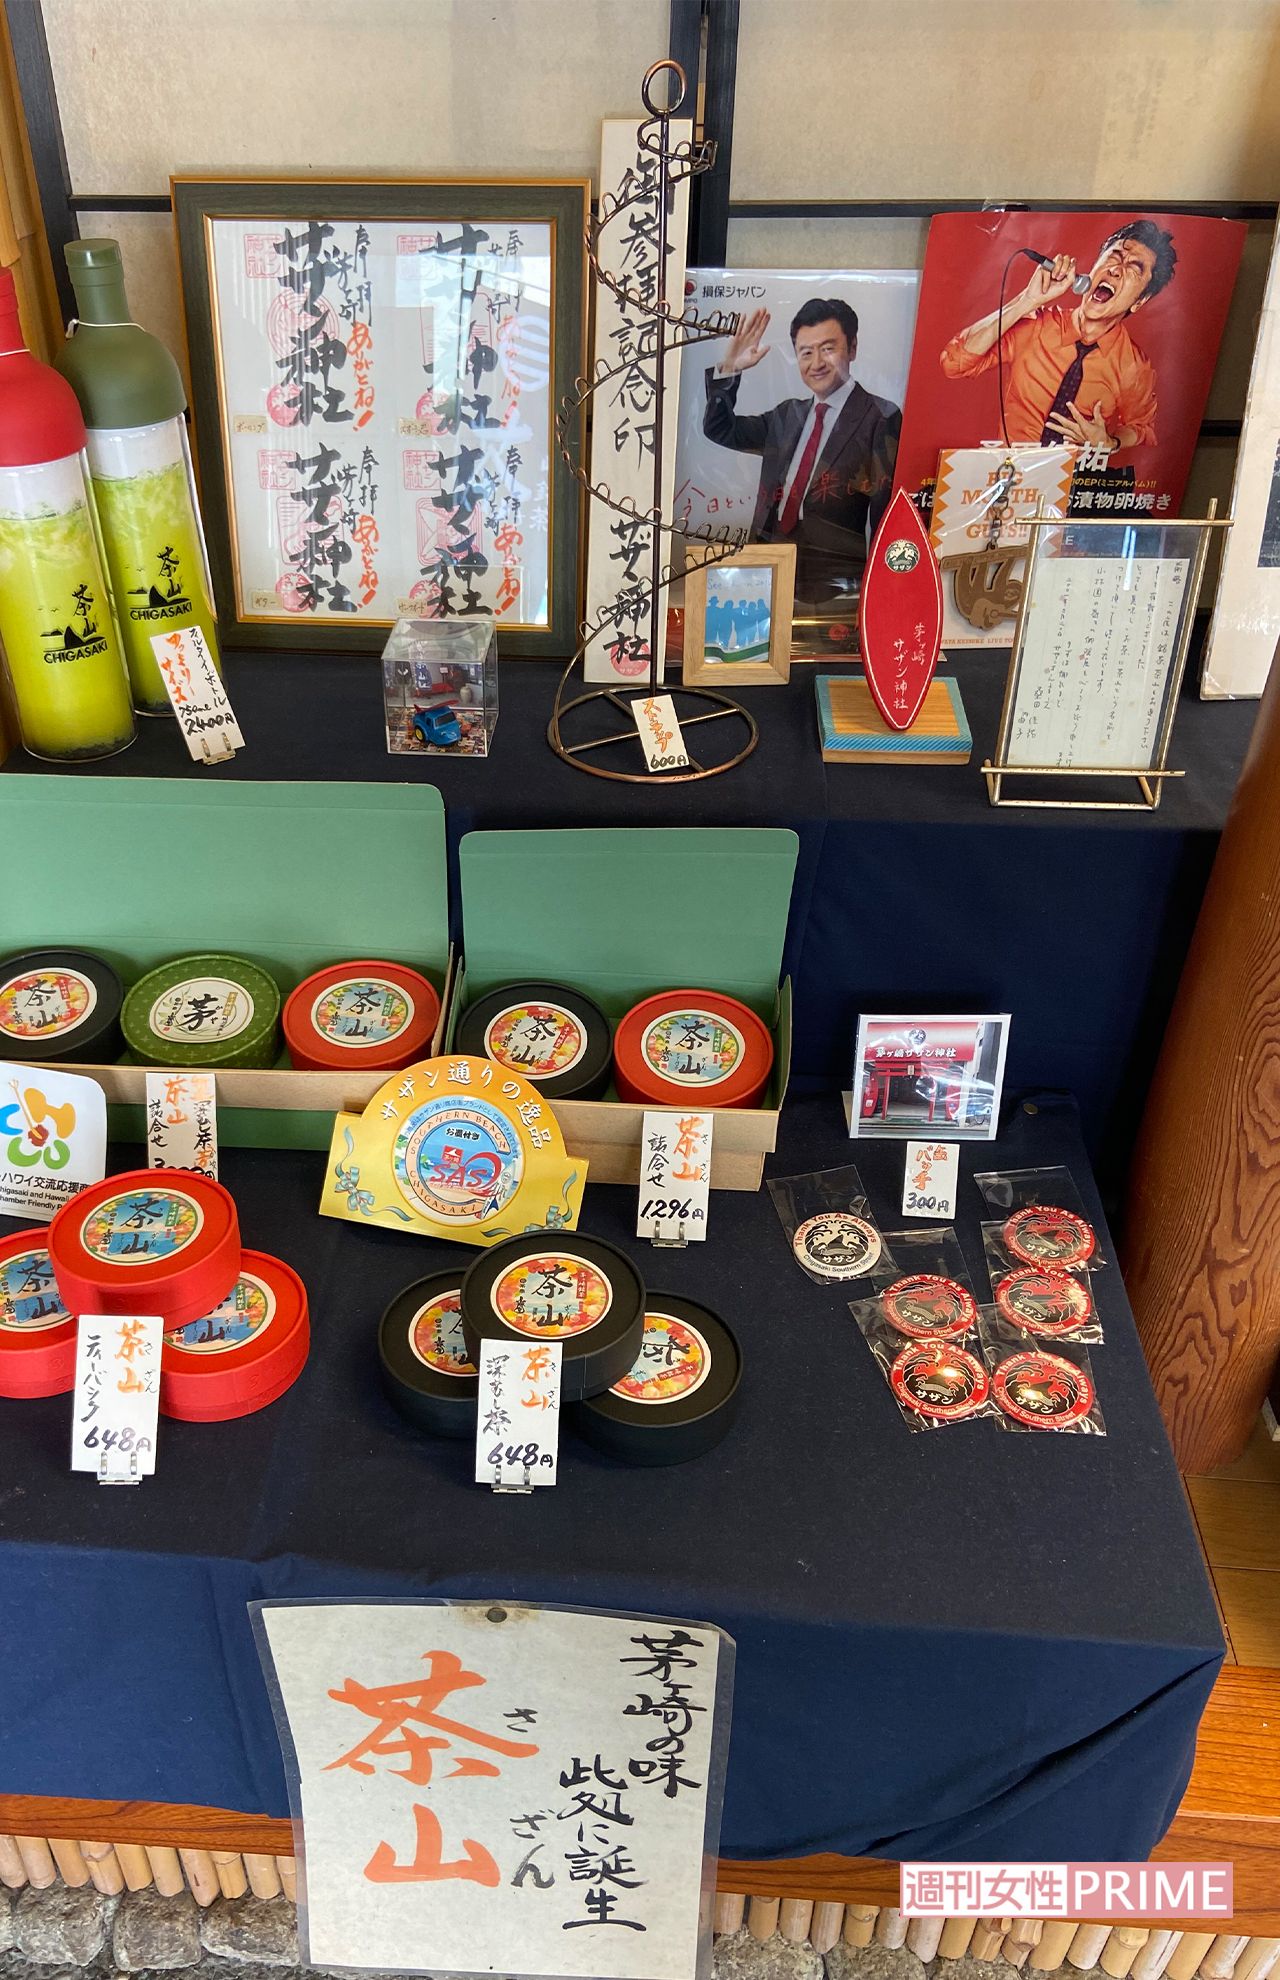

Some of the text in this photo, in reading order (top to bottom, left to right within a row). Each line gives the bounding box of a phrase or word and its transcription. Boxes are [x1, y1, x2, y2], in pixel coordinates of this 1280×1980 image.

[702, 285, 766, 298] 損保ジャパン
[129, 602, 193, 621] CHIGASAKI
[44, 642, 109, 664] CHIGASAKI
[893, 638, 908, 710] サザン神社
[651, 754, 687, 769] 600円
[675, 1020, 710, 1075] 茶山
[380, 1060, 553, 1150] サザン通りの逸品
[410, 1111, 470, 1155] SOUTHERN
[475, 1115, 506, 1148] BEACH
[429, 1163, 488, 1188] SAS
[0, 1186, 28, 1197] higasaki
[30, 1191, 44, 1199] and
[0, 1195, 26, 1205] hamber
[28, 1199, 56, 1210] Friendly
[410, 1170, 476, 1214] CHIGASAKI
[906, 1192, 949, 1212] 300円
[120, 1197, 163, 1254] 茶山
[795, 1218, 810, 1247] Thank
[813, 1213, 831, 1223] You
[852, 1217, 877, 1243] Always
[1008, 1208, 1033, 1227] Thank
[1061, 1209, 1074, 1219] As
[822, 1255, 856, 1263] サザン
[1006, 1267, 1039, 1282] Thank
[1042, 1267, 1065, 1278] You
[531, 1263, 573, 1327] 茶山
[889, 1274, 973, 1322] Thank You As Always
[901, 1309, 934, 1327] サザン
[114, 1319, 148, 1394] 茶山
[893, 1346, 921, 1371] Thank
[923, 1342, 945, 1350] You
[948, 1345, 963, 1356] As
[996, 1354, 1026, 1376] Thank
[520, 1345, 552, 1411] 茶山
[915, 1389, 953, 1404] サザン
[1016, 1396, 1054, 1413] サザン
[84, 1425, 152, 1452] 648円
[487, 1442, 554, 1468] 648円
[503, 1707, 539, 1734] さ
[619, 1630, 708, 1799] 茅ヶ崎の味
[319, 1649, 540, 1888] 茶山
[510, 1808, 558, 1890] ざん
[556, 1753, 650, 1933] 此処に誕生
